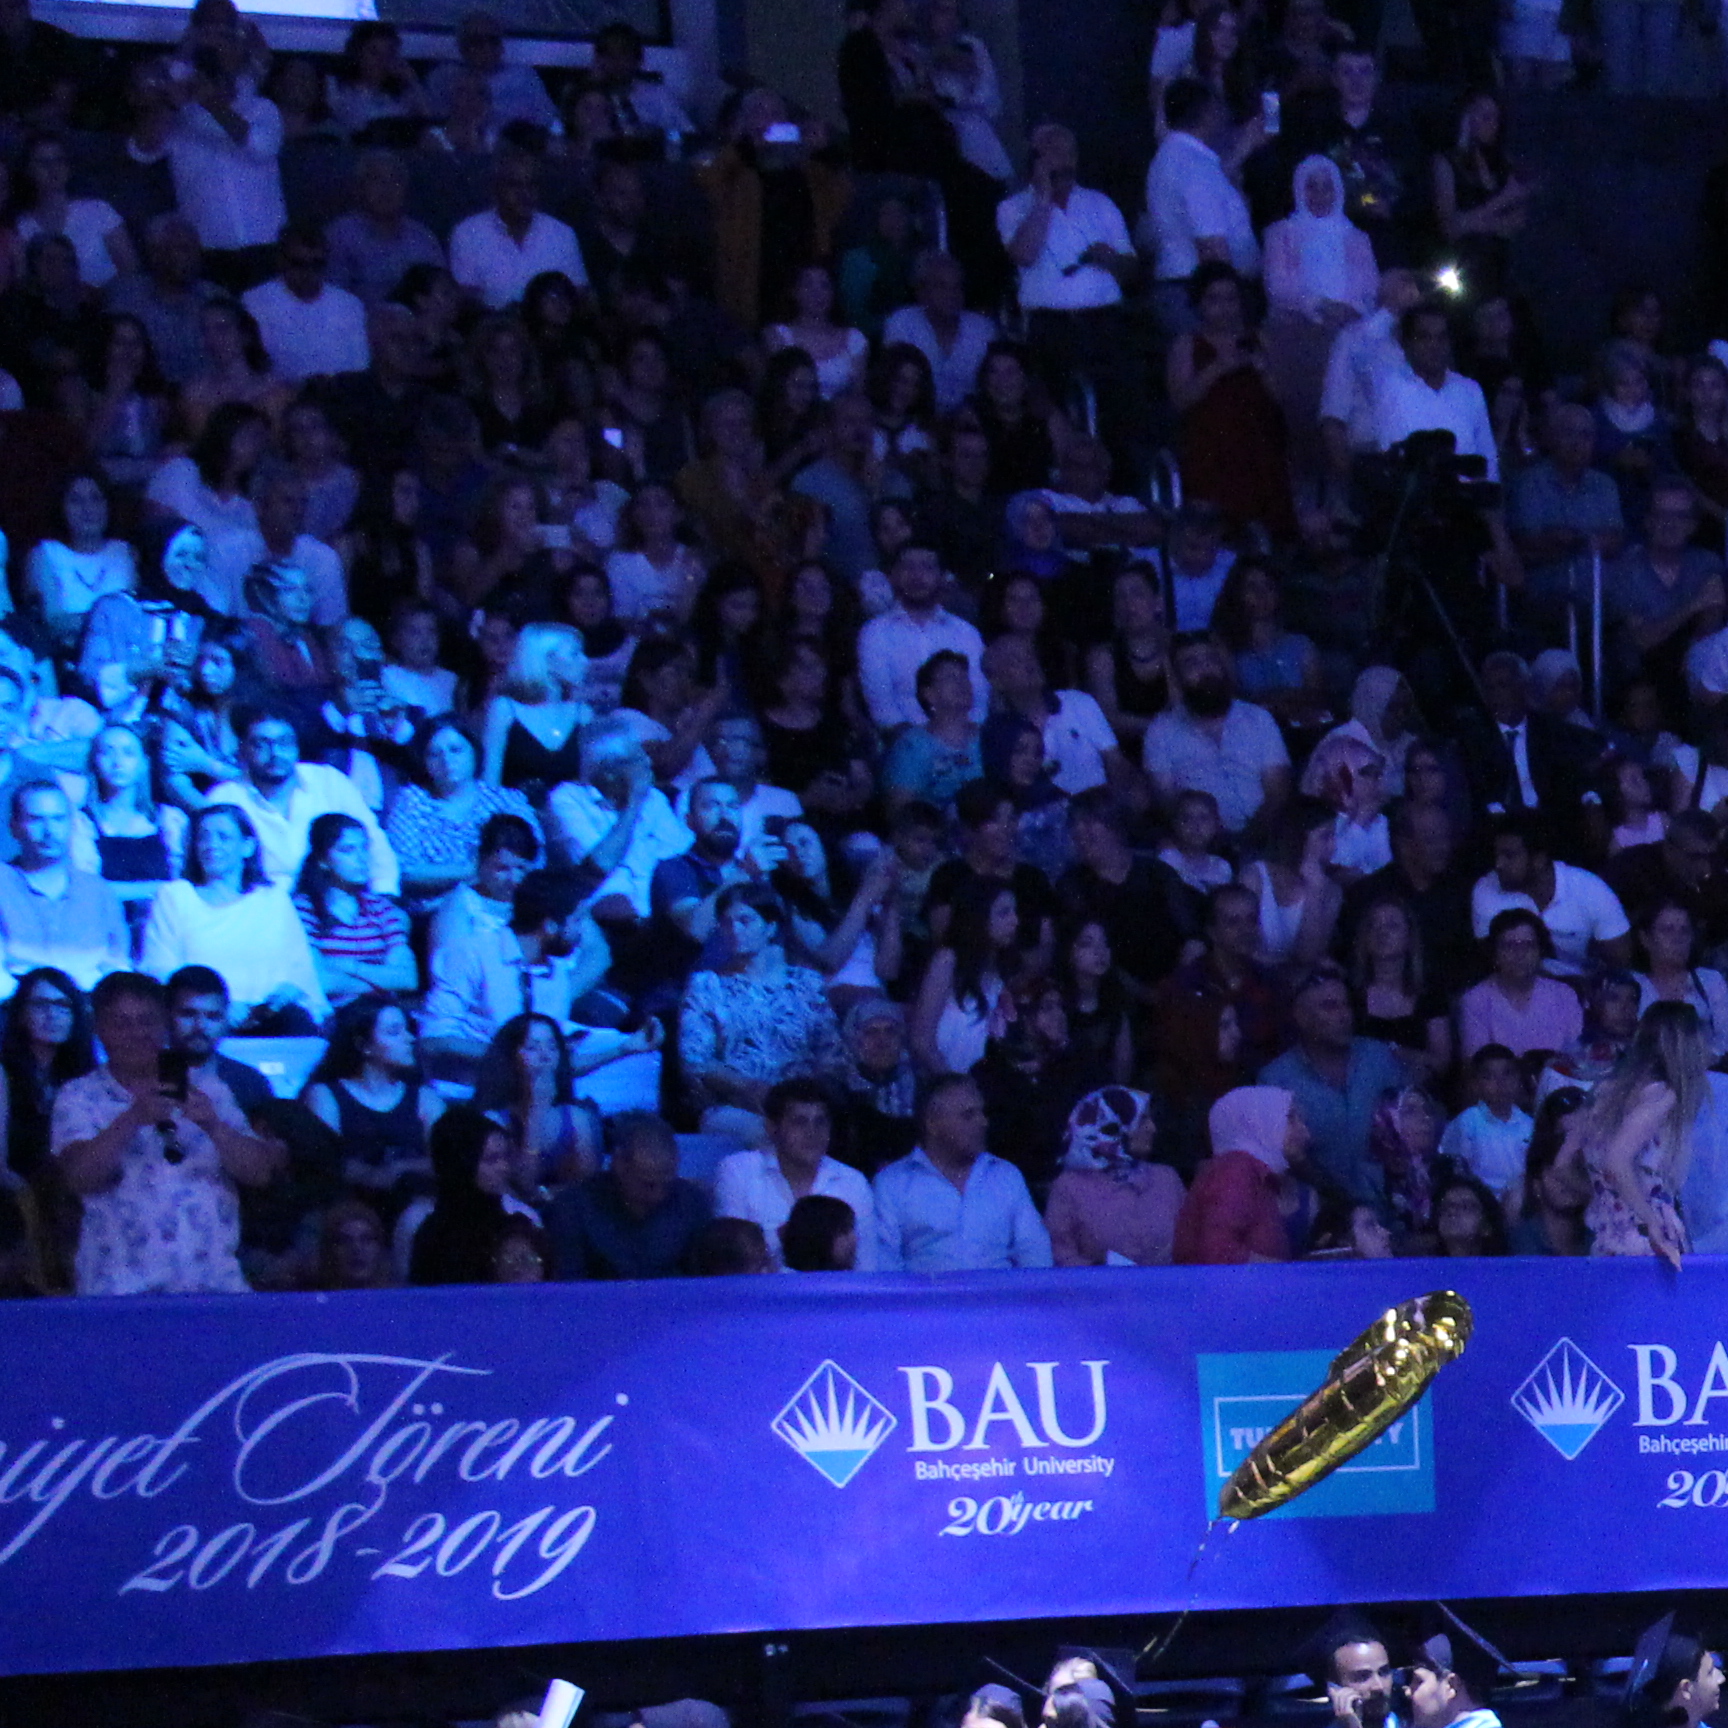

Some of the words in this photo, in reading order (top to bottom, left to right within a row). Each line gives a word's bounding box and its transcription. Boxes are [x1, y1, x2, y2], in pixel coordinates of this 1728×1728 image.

[235, 1351, 629, 1505] Töreni
[897, 1360, 1111, 1452] BAU
[915, 1458, 1016, 1482] Bahçeşehir
[1023, 1454, 1115, 1478] University
[117, 1503, 598, 1601] 2018-2019
